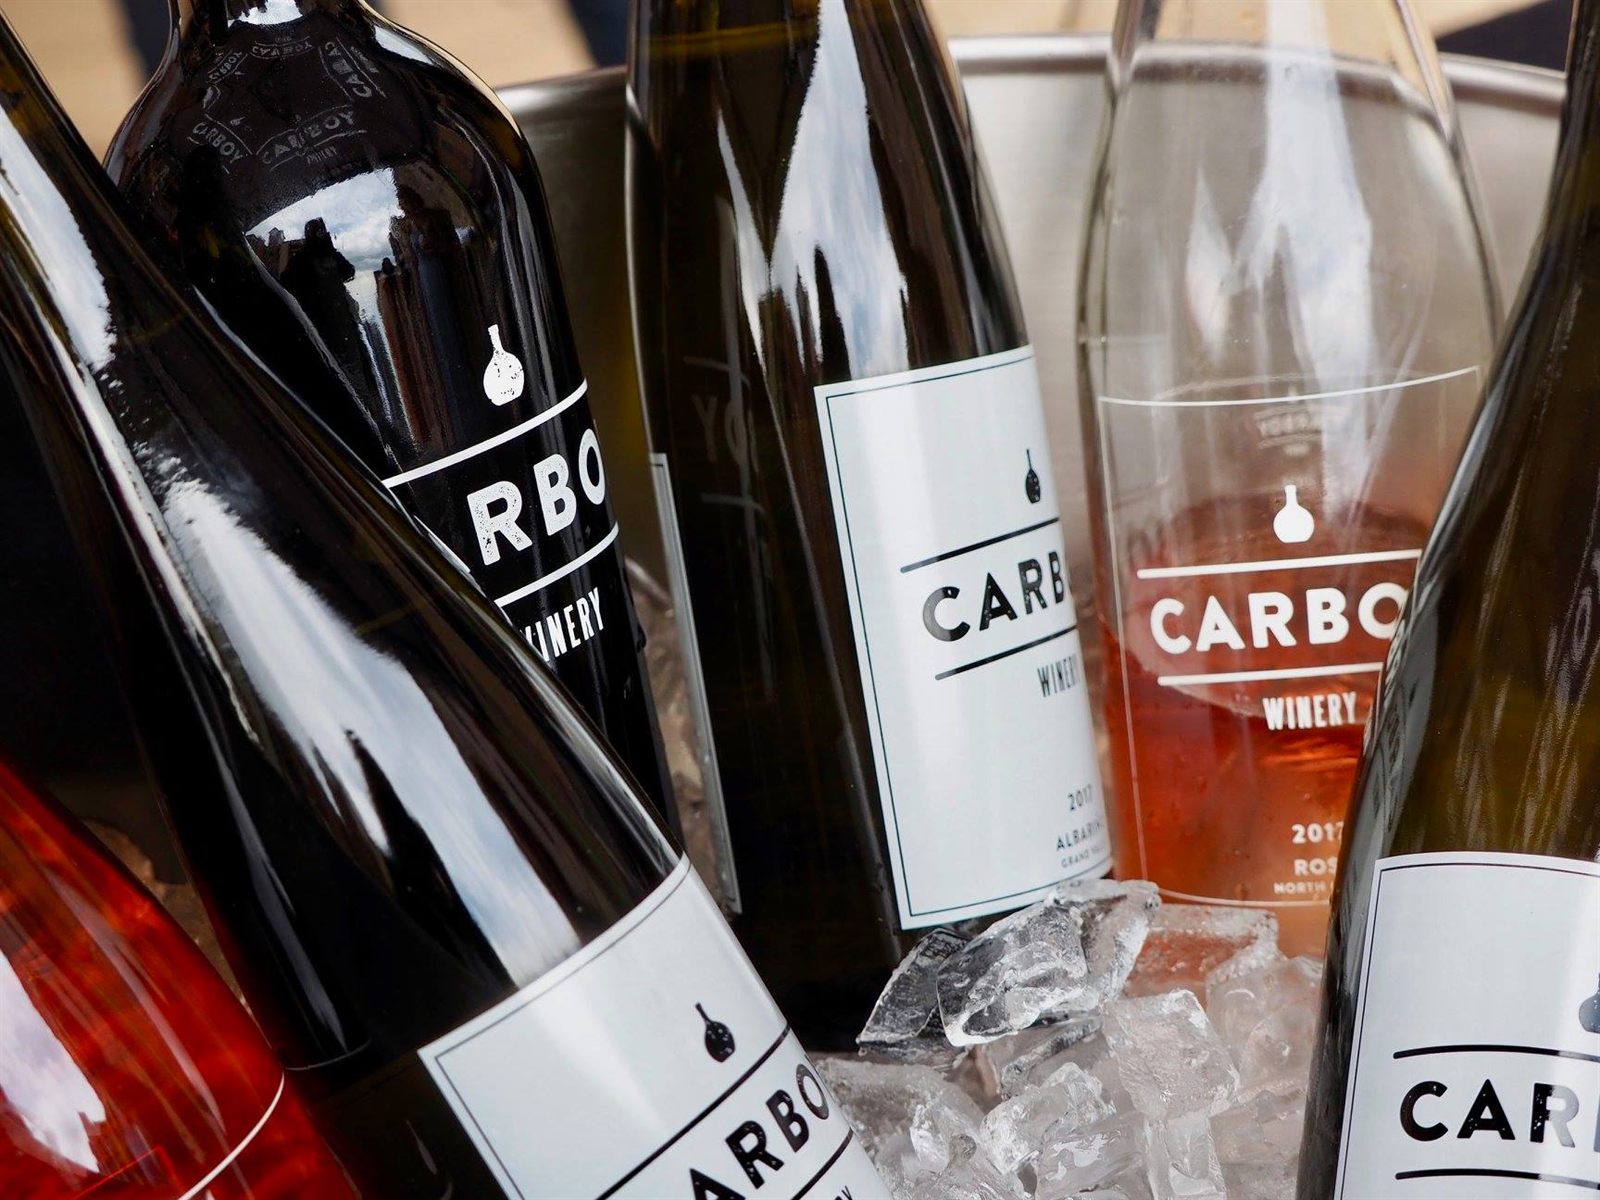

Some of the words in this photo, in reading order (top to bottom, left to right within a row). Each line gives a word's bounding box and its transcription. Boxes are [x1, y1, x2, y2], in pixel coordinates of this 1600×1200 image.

[1150, 582, 1409, 655] CARBO
[1262, 691, 1357, 731] WINERY
[1400, 1078, 1600, 1153] CAR
